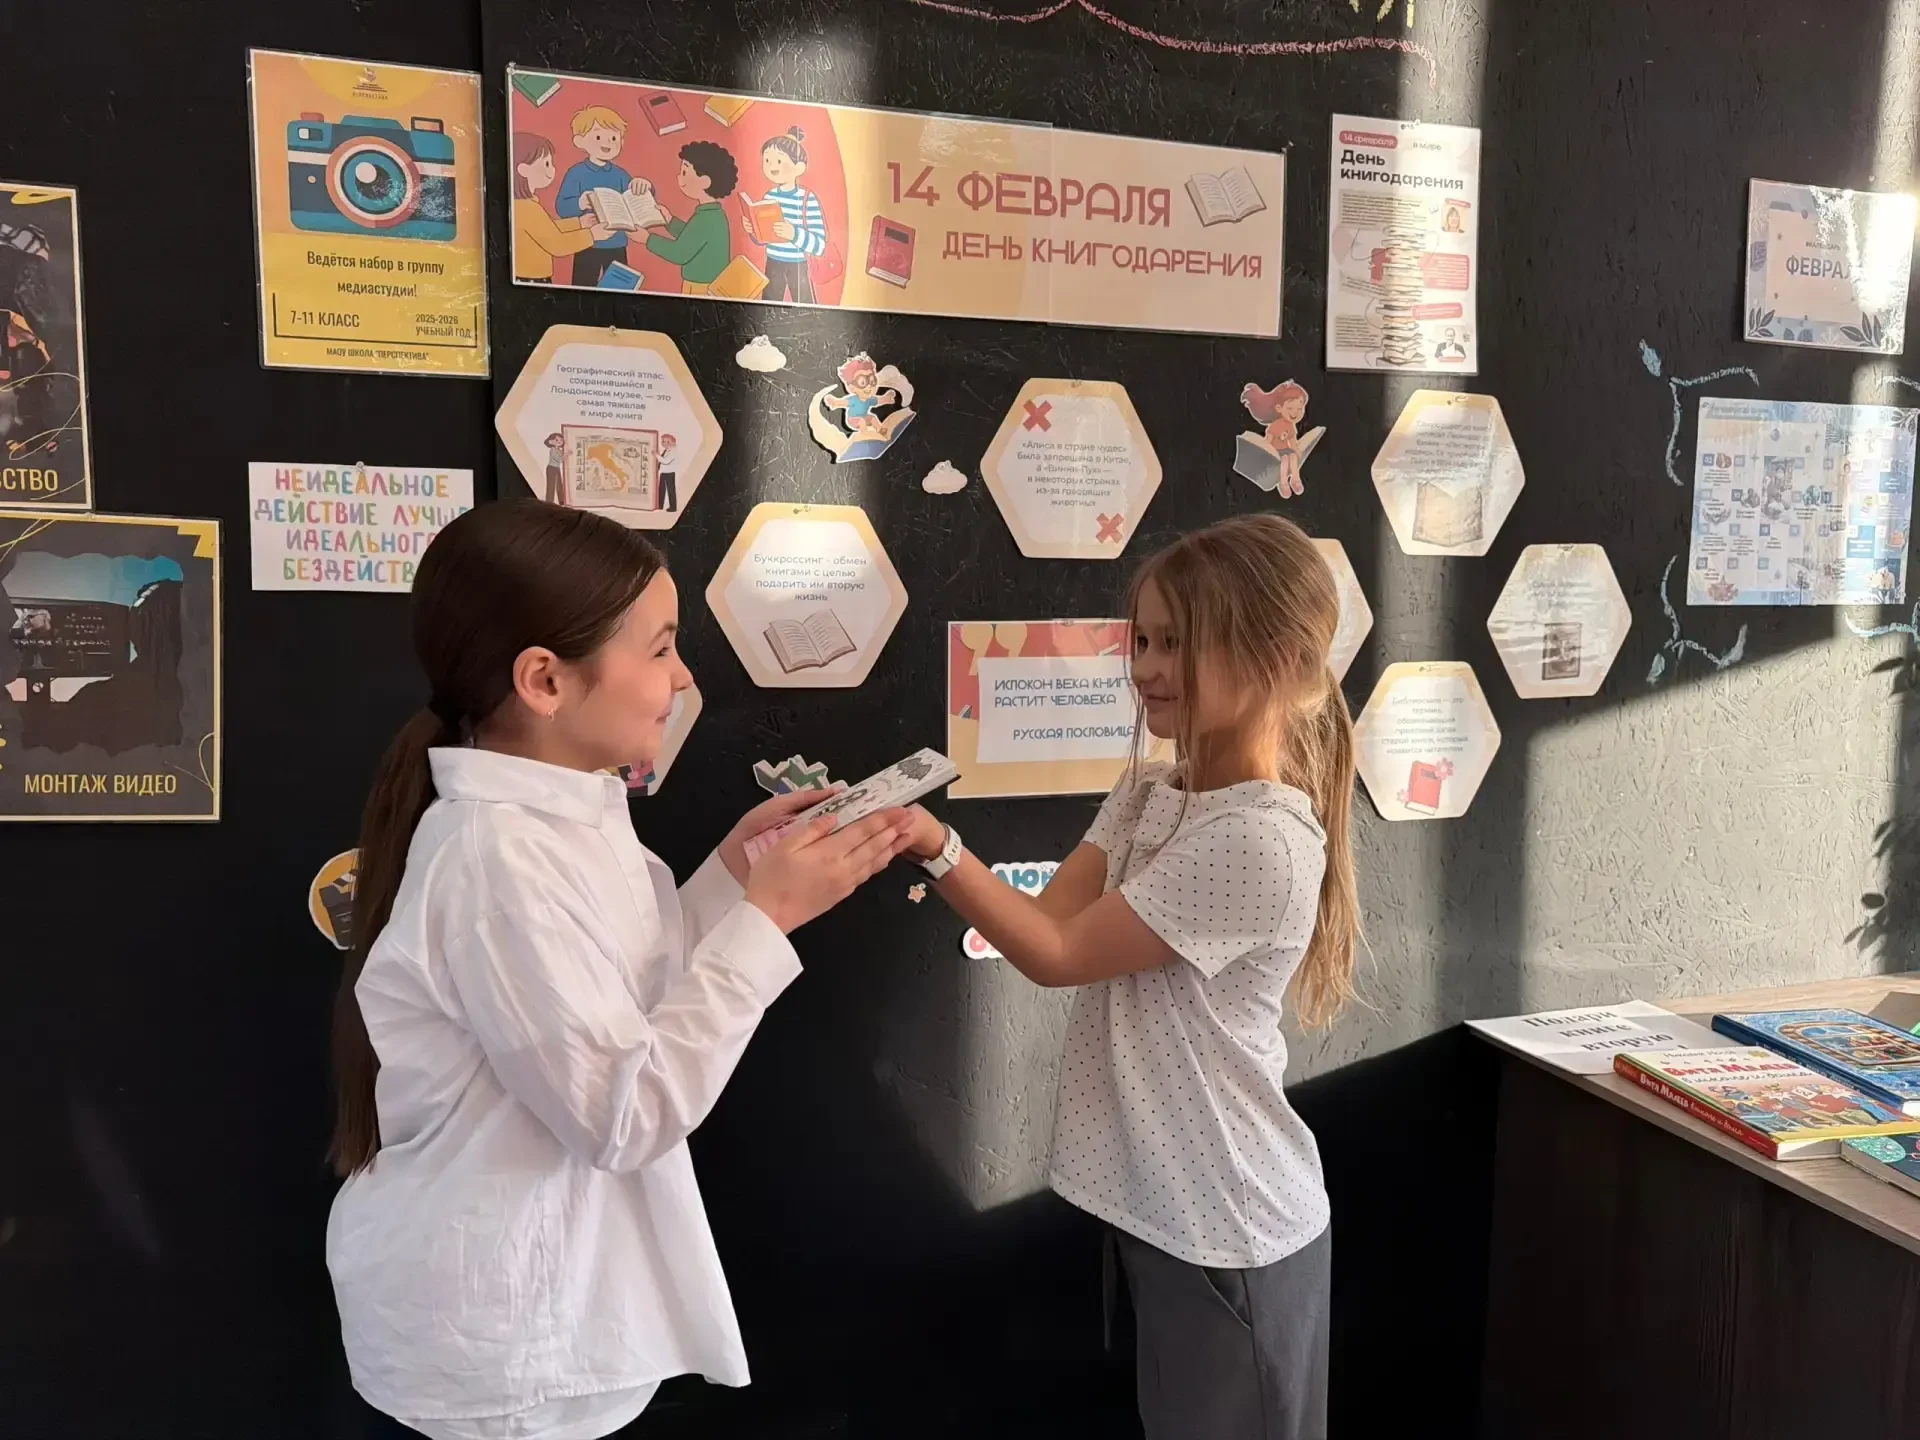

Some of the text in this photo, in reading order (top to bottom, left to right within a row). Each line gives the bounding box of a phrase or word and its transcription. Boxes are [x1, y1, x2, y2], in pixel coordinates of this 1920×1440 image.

[1340, 149, 1386, 166] День
[1340, 168, 1464, 190] книгодарения
[886, 161, 1171, 228] 14 ФЕВРАЛЯ
[942, 231, 1262, 279] ДЕНЬ КНИГОДАРЕНИЯ
[307, 250, 445, 276] Ведётся набор в группу
[1786, 255, 1850, 280] ФЕВРА
[337, 282, 417, 298] медиастудии!
[290, 310, 360, 328] 7-11 КЛАСС
[415, 313, 459, 325] 2025-2026
[415, 325, 472, 339] УЧЕБНЫЙ ГОД
[326, 347, 346, 357] МАОУ
[347, 349, 374, 358] ШКОЛА
[556, 364, 635, 378] Географический
[569, 377, 645, 389] сохранившийся
[550, 385, 612, 397] Лондонском
[613, 391, 644, 400] музее,
[657, 394, 672, 402] это
[576, 399, 646, 410] самая тяжелая
[588, 411, 614, 419] мире
[615, 413, 643, 421] книга
[1017, 451, 1041, 460] была
[0, 468, 58, 491] СТВО
[275, 468, 449, 498] НЕИДЕАЛЬНОЕ
[254, 494, 378, 526] ДЕЙСТВИЕ
[754, 553, 823, 565] Буккроссинг
[833, 556, 867, 565] обмен
[283, 555, 414, 584] БЕЗДЕЙСТВ
[765, 567, 811, 577] книгами
[823, 570, 856, 578] целью
[756, 580, 807, 589] подарить
[827, 582, 865, 592] вторую
[794, 593, 828, 601] жизнь
[994, 679, 1053, 691] ИСПОКОН
[1055, 678, 1089, 690] ВЕКА
[994, 694, 1116, 708] РАСТИТ ЧЕЛОВЕКА
[1013, 728, 1063, 741] РУССКАЯ
[24, 774, 177, 796] МОНТАЖ ВИДЕО
[1522, 1011, 1618, 1028] Подари
[1559, 1023, 1632, 1038] книге
[1581, 1033, 1675, 1052] вторую
